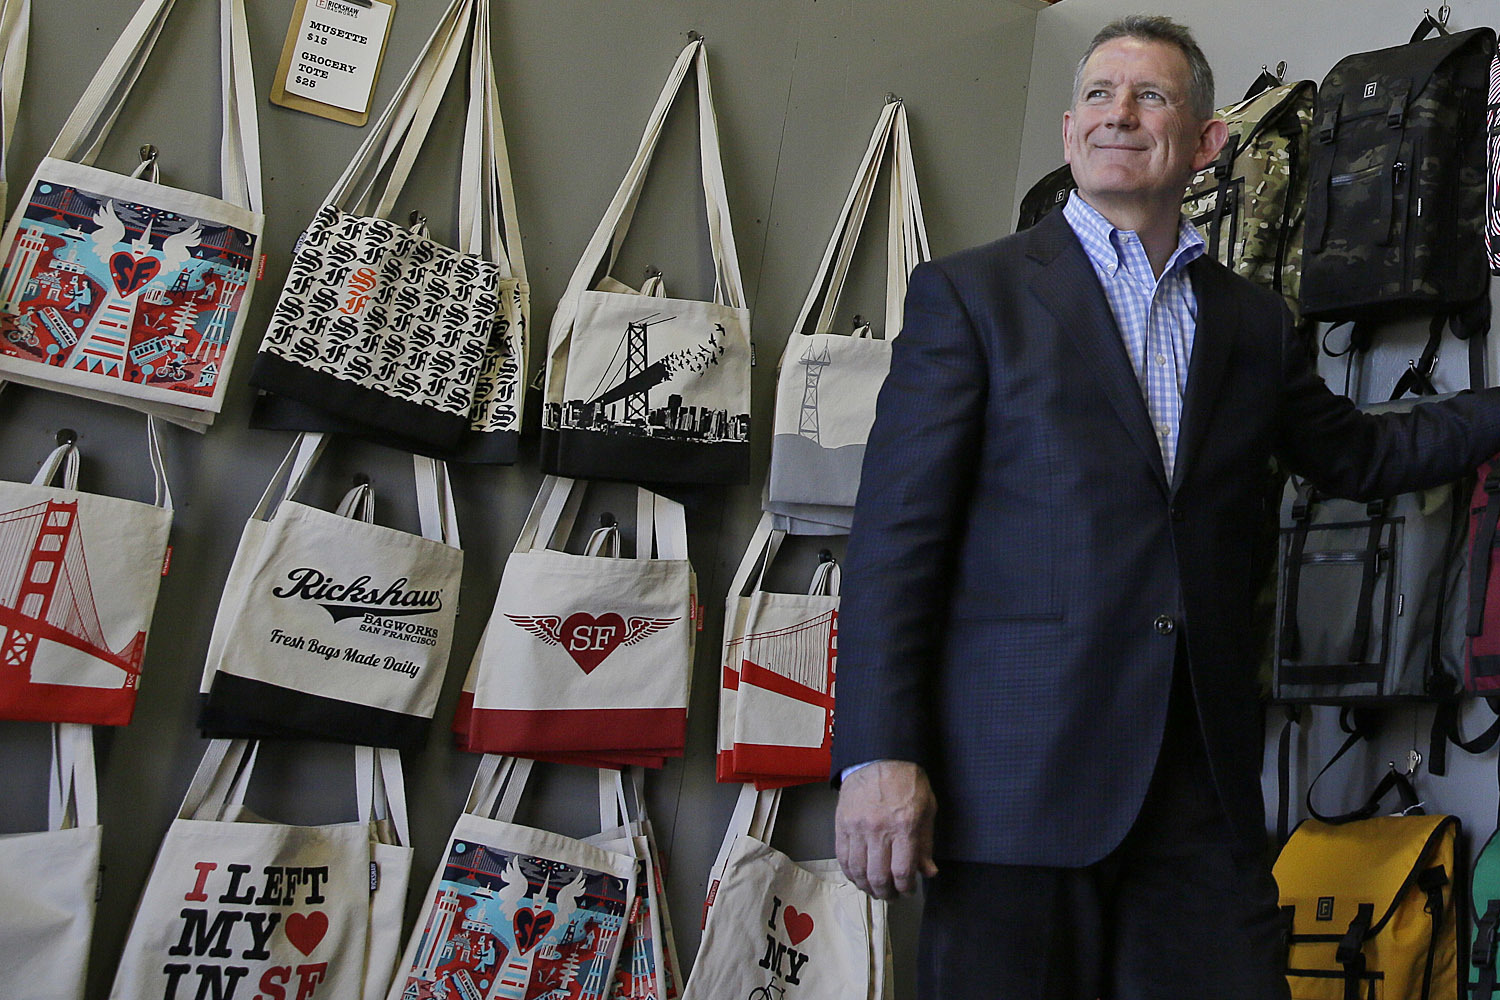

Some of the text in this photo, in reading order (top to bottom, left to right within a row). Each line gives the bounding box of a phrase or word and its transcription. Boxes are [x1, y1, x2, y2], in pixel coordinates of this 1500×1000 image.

[327, 0, 360, 15] RICKSHAW
[306, 32, 328, 46] $15
[309, 20, 368, 45] MUSETTE
[298, 63, 329, 79] TOTE
[301, 51, 357, 74] GROCERY
[295, 75, 316, 88] $25
[114, 254, 157, 291] SF
[272, 567, 442, 607] Rickshaw
[359, 624, 437, 647] SAN FRANCISCO
[362, 613, 439, 639] BAGWORKS
[570, 625, 616, 651] SF
[269, 629, 421, 679] Fresh Bags Made Daily
[184, 861, 329, 907] I LEFT
[768, 895, 782, 931] I
[168, 908, 282, 961] MY
[517, 910, 552, 948] SF
[759, 933, 809, 986] MY
[162, 961, 329, 1000] IN SF
